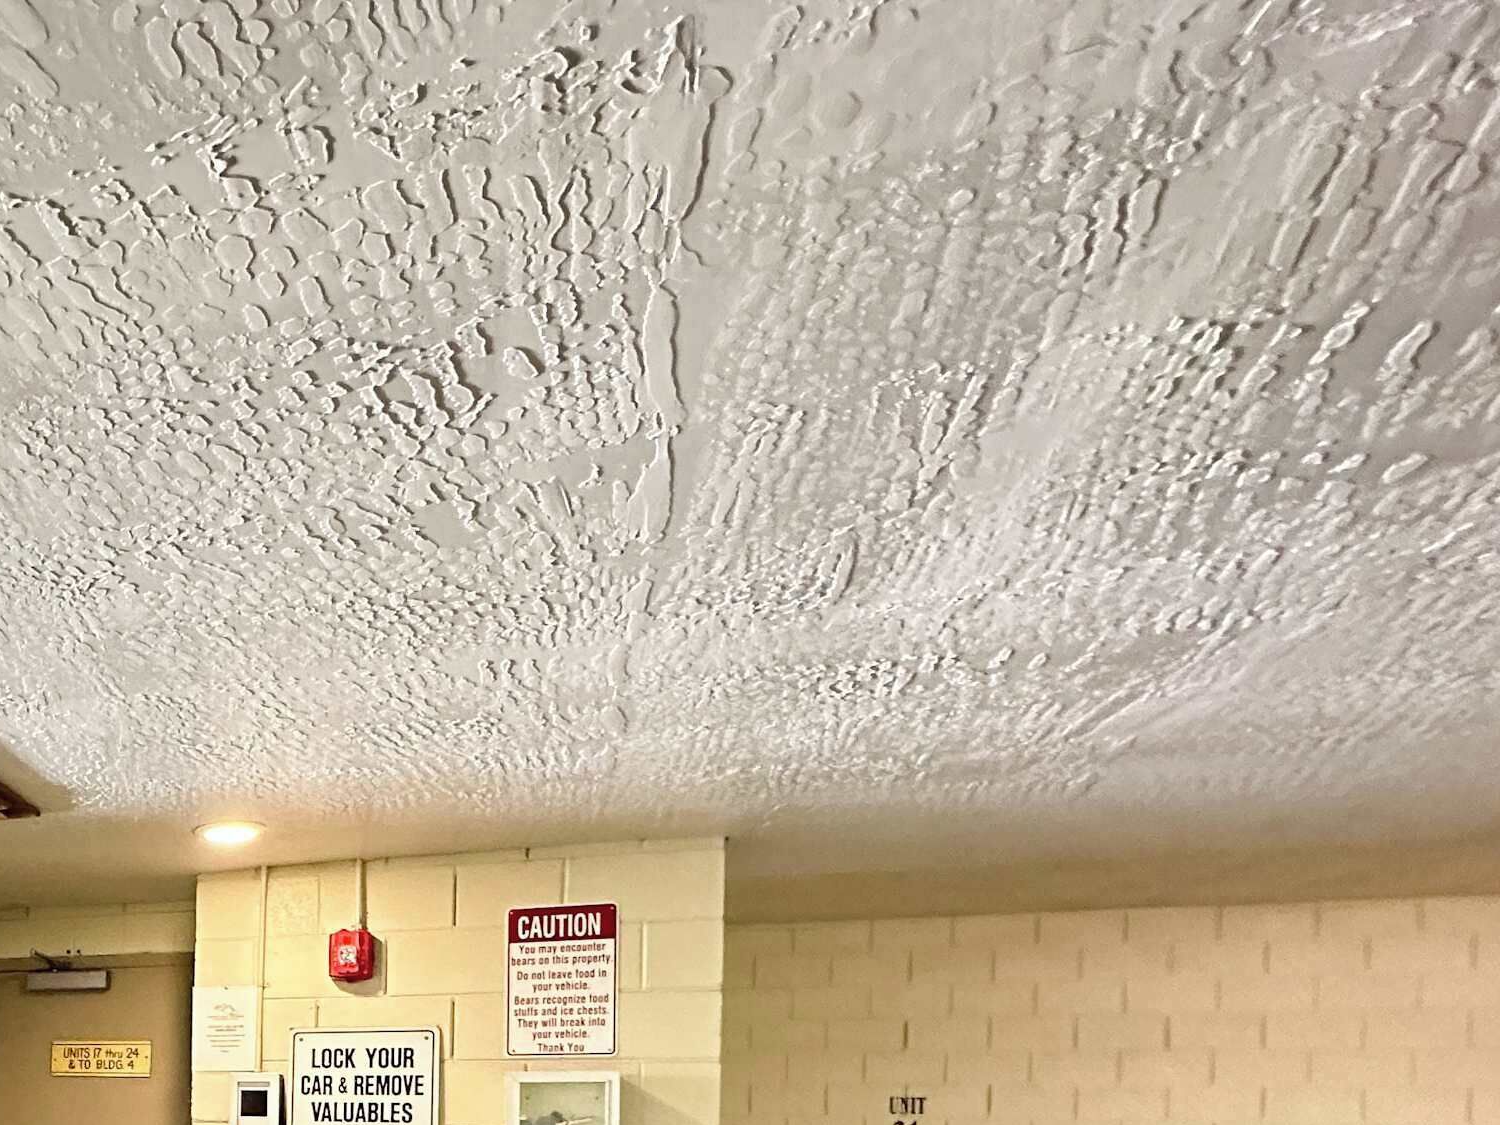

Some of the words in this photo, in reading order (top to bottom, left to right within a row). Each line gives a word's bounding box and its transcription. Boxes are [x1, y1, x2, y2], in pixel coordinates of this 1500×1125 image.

[517, 911, 602, 940] CAUTION
[518, 944, 536, 955] You
[538, 945, 557, 955] may
[560, 942, 607, 953] encounter
[511, 957, 536, 967] bears
[539, 957, 550, 966] on
[552, 955, 569, 965] this
[572, 953, 614, 965] property.
[516, 971, 529, 981] Do
[531, 971, 546, 980] not
[548, 970, 573, 979] leave
[575, 968, 595, 978] food
[598, 968, 607, 977] in
[532, 982, 552, 993] your
[555, 981, 591, 991] vehicle.
[514, 995, 540, 1006] Bears
[542, 995, 587, 1006] recognize
[589, 993, 609, 1004] food
[513, 1007, 539, 1017] stuffs
[541, 1006, 558, 1016] and
[560, 1006, 574, 1015] ice
[517, 1018, 539, 1029] They
[541, 1018, 557, 1027] will
[560, 1017, 586, 1027] break
[588, 1017, 606, 1027] into
[532, 1030, 552, 1041] your
[555, 1028, 591, 1039] vehicle.
[63, 1047, 91, 1059] UNITS
[93, 1047, 102, 1059] 17
[105, 1048, 124, 1059] thru
[126, 1047, 140, 1059] 24
[537, 1043, 565, 1052] Thank
[567, 1042, 585, 1052] You
[311, 1047, 357, 1069] LOCK
[365, 1047, 415, 1069] YOUR
[67, 1060, 76, 1070] &
[79, 1060, 91, 1070] TO
[127, 1060, 134, 1070] 4
[300, 1074, 333, 1096] CAR
[338, 1076, 349, 1094] &
[354, 1074, 425, 1096] REMOVE
[889, 1096, 927, 1115] UNIT
[311, 1101, 413, 1124] VALUABLES
